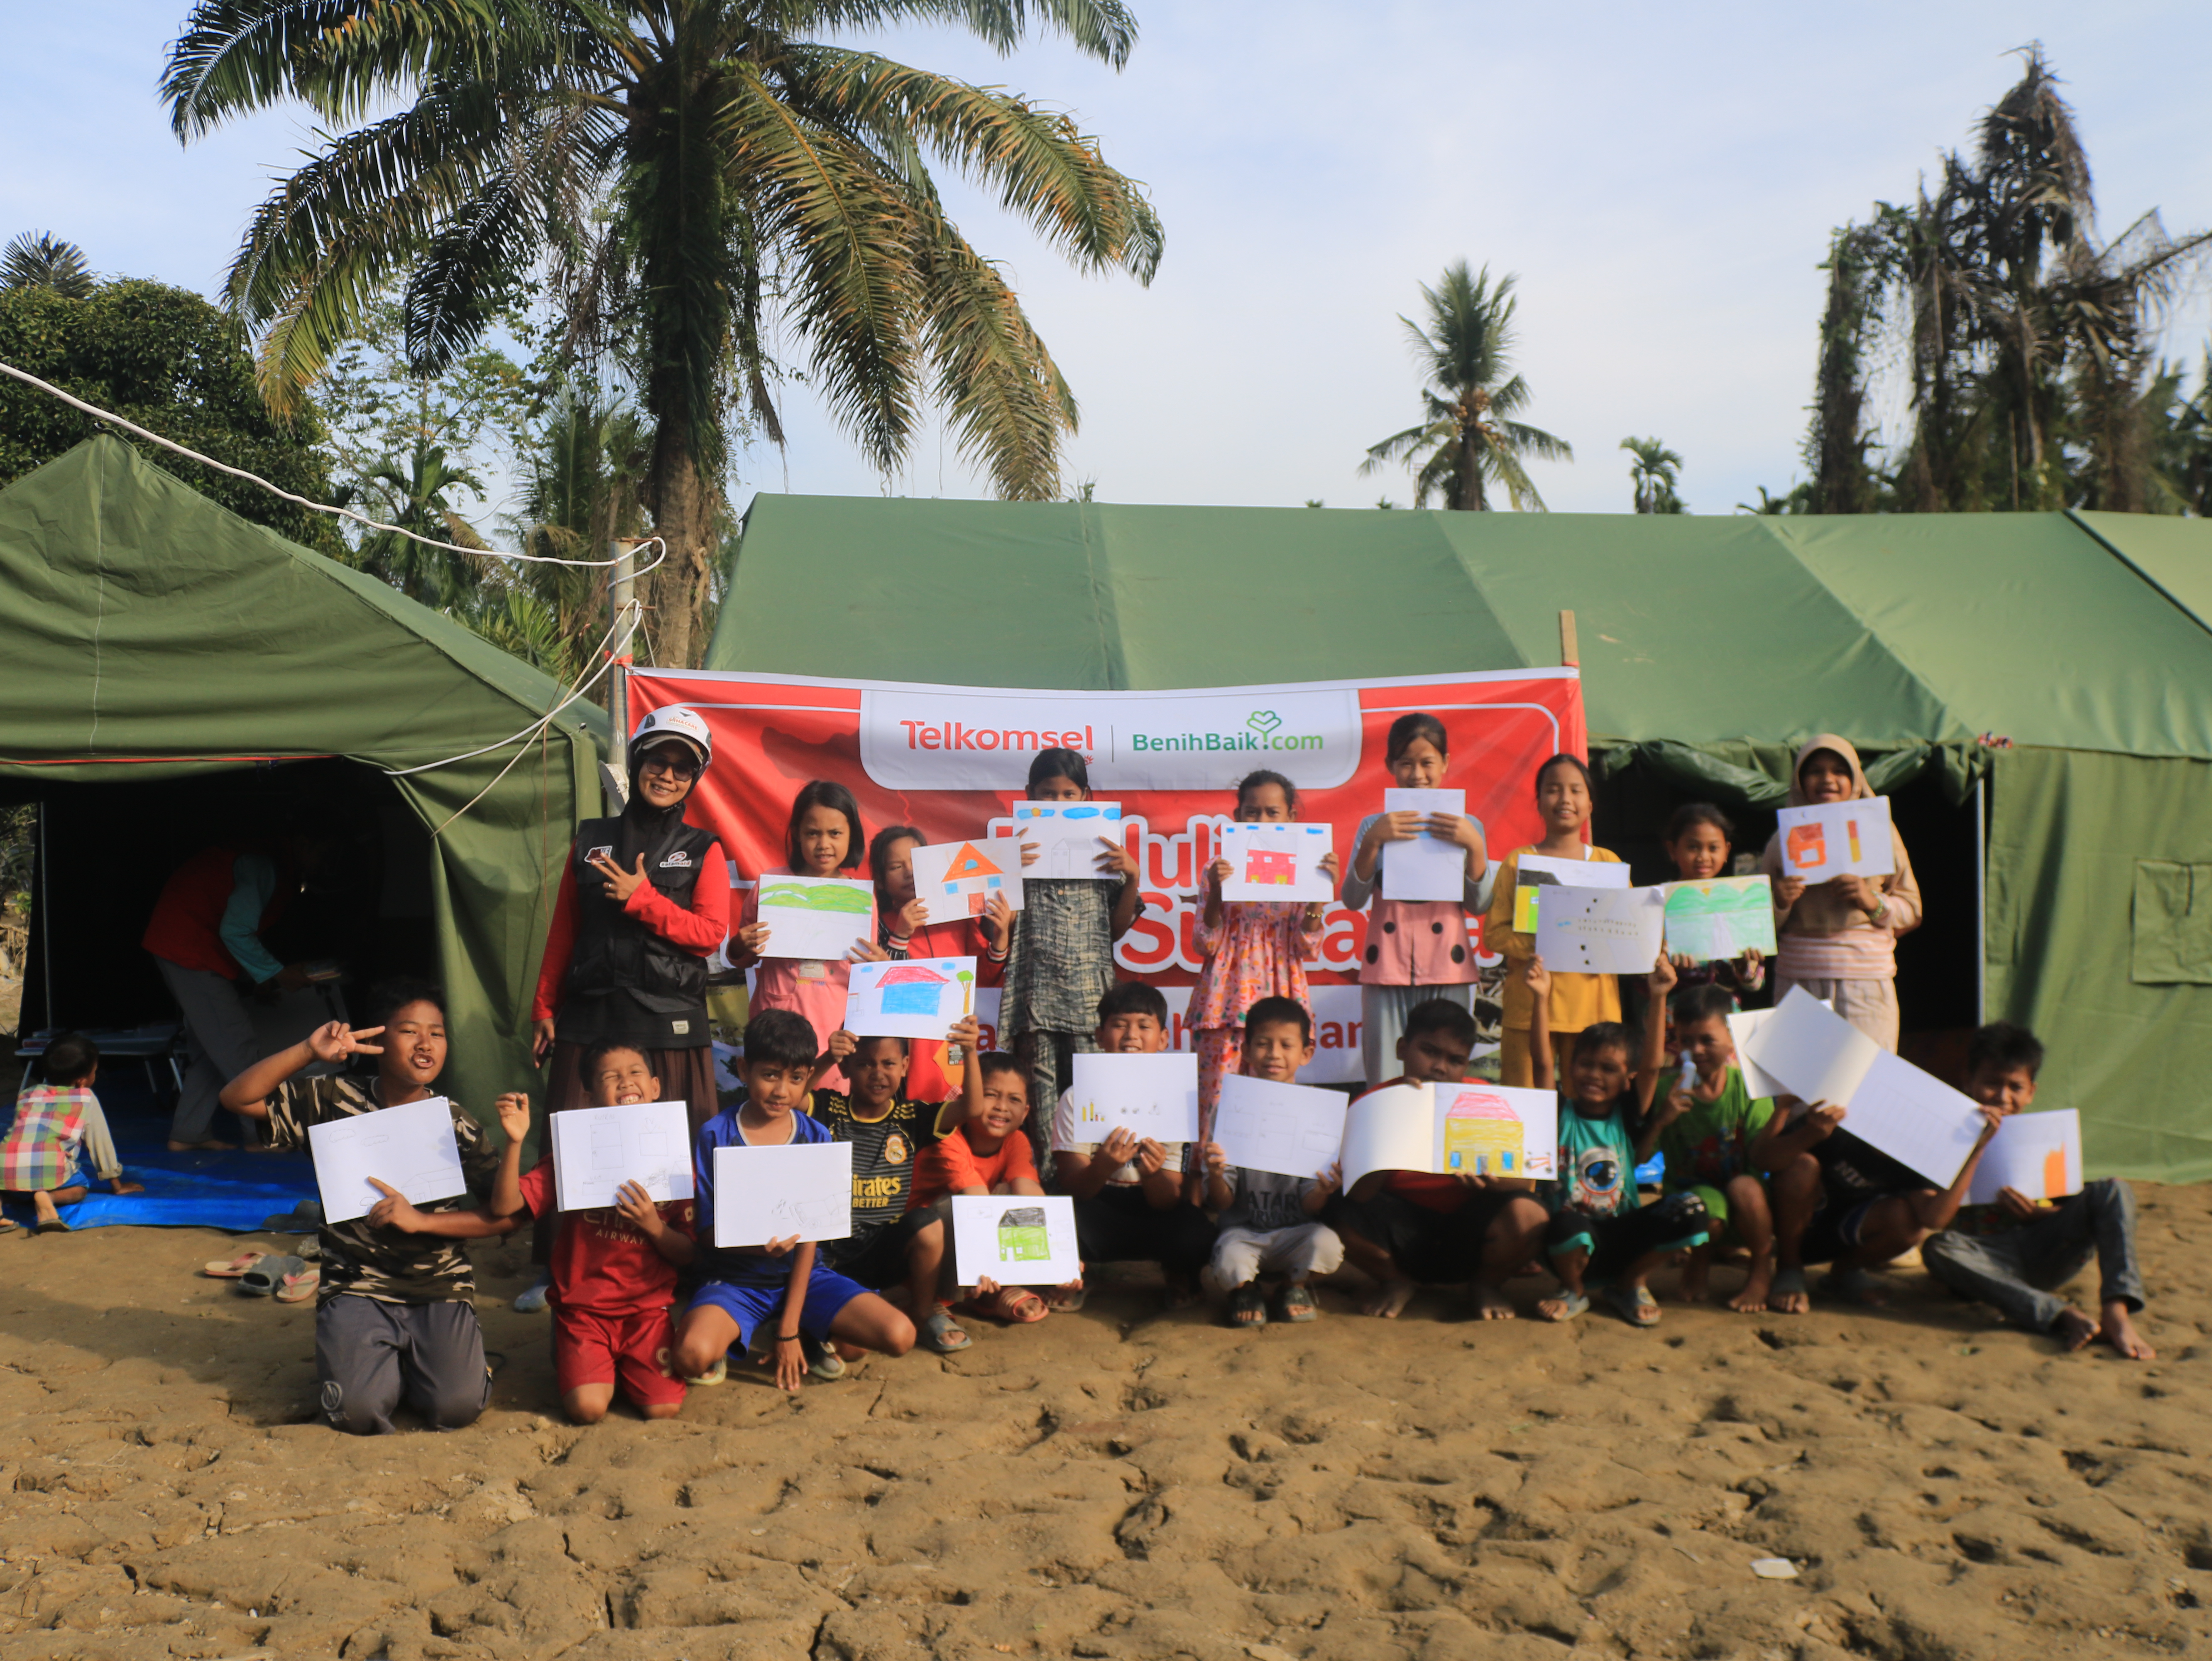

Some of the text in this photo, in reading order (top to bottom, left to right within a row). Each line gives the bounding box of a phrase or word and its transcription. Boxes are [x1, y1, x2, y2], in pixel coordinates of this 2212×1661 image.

[899, 720, 1094, 750] Telkomsel
[1132, 732, 1324, 751] BenihBaik.com
[852, 1173, 901, 1196] irates
[852, 1197, 889, 1208] BETTER
[1247, 1191, 1298, 1212] ATAR
[595, 1229, 646, 1245] AIRWAY
